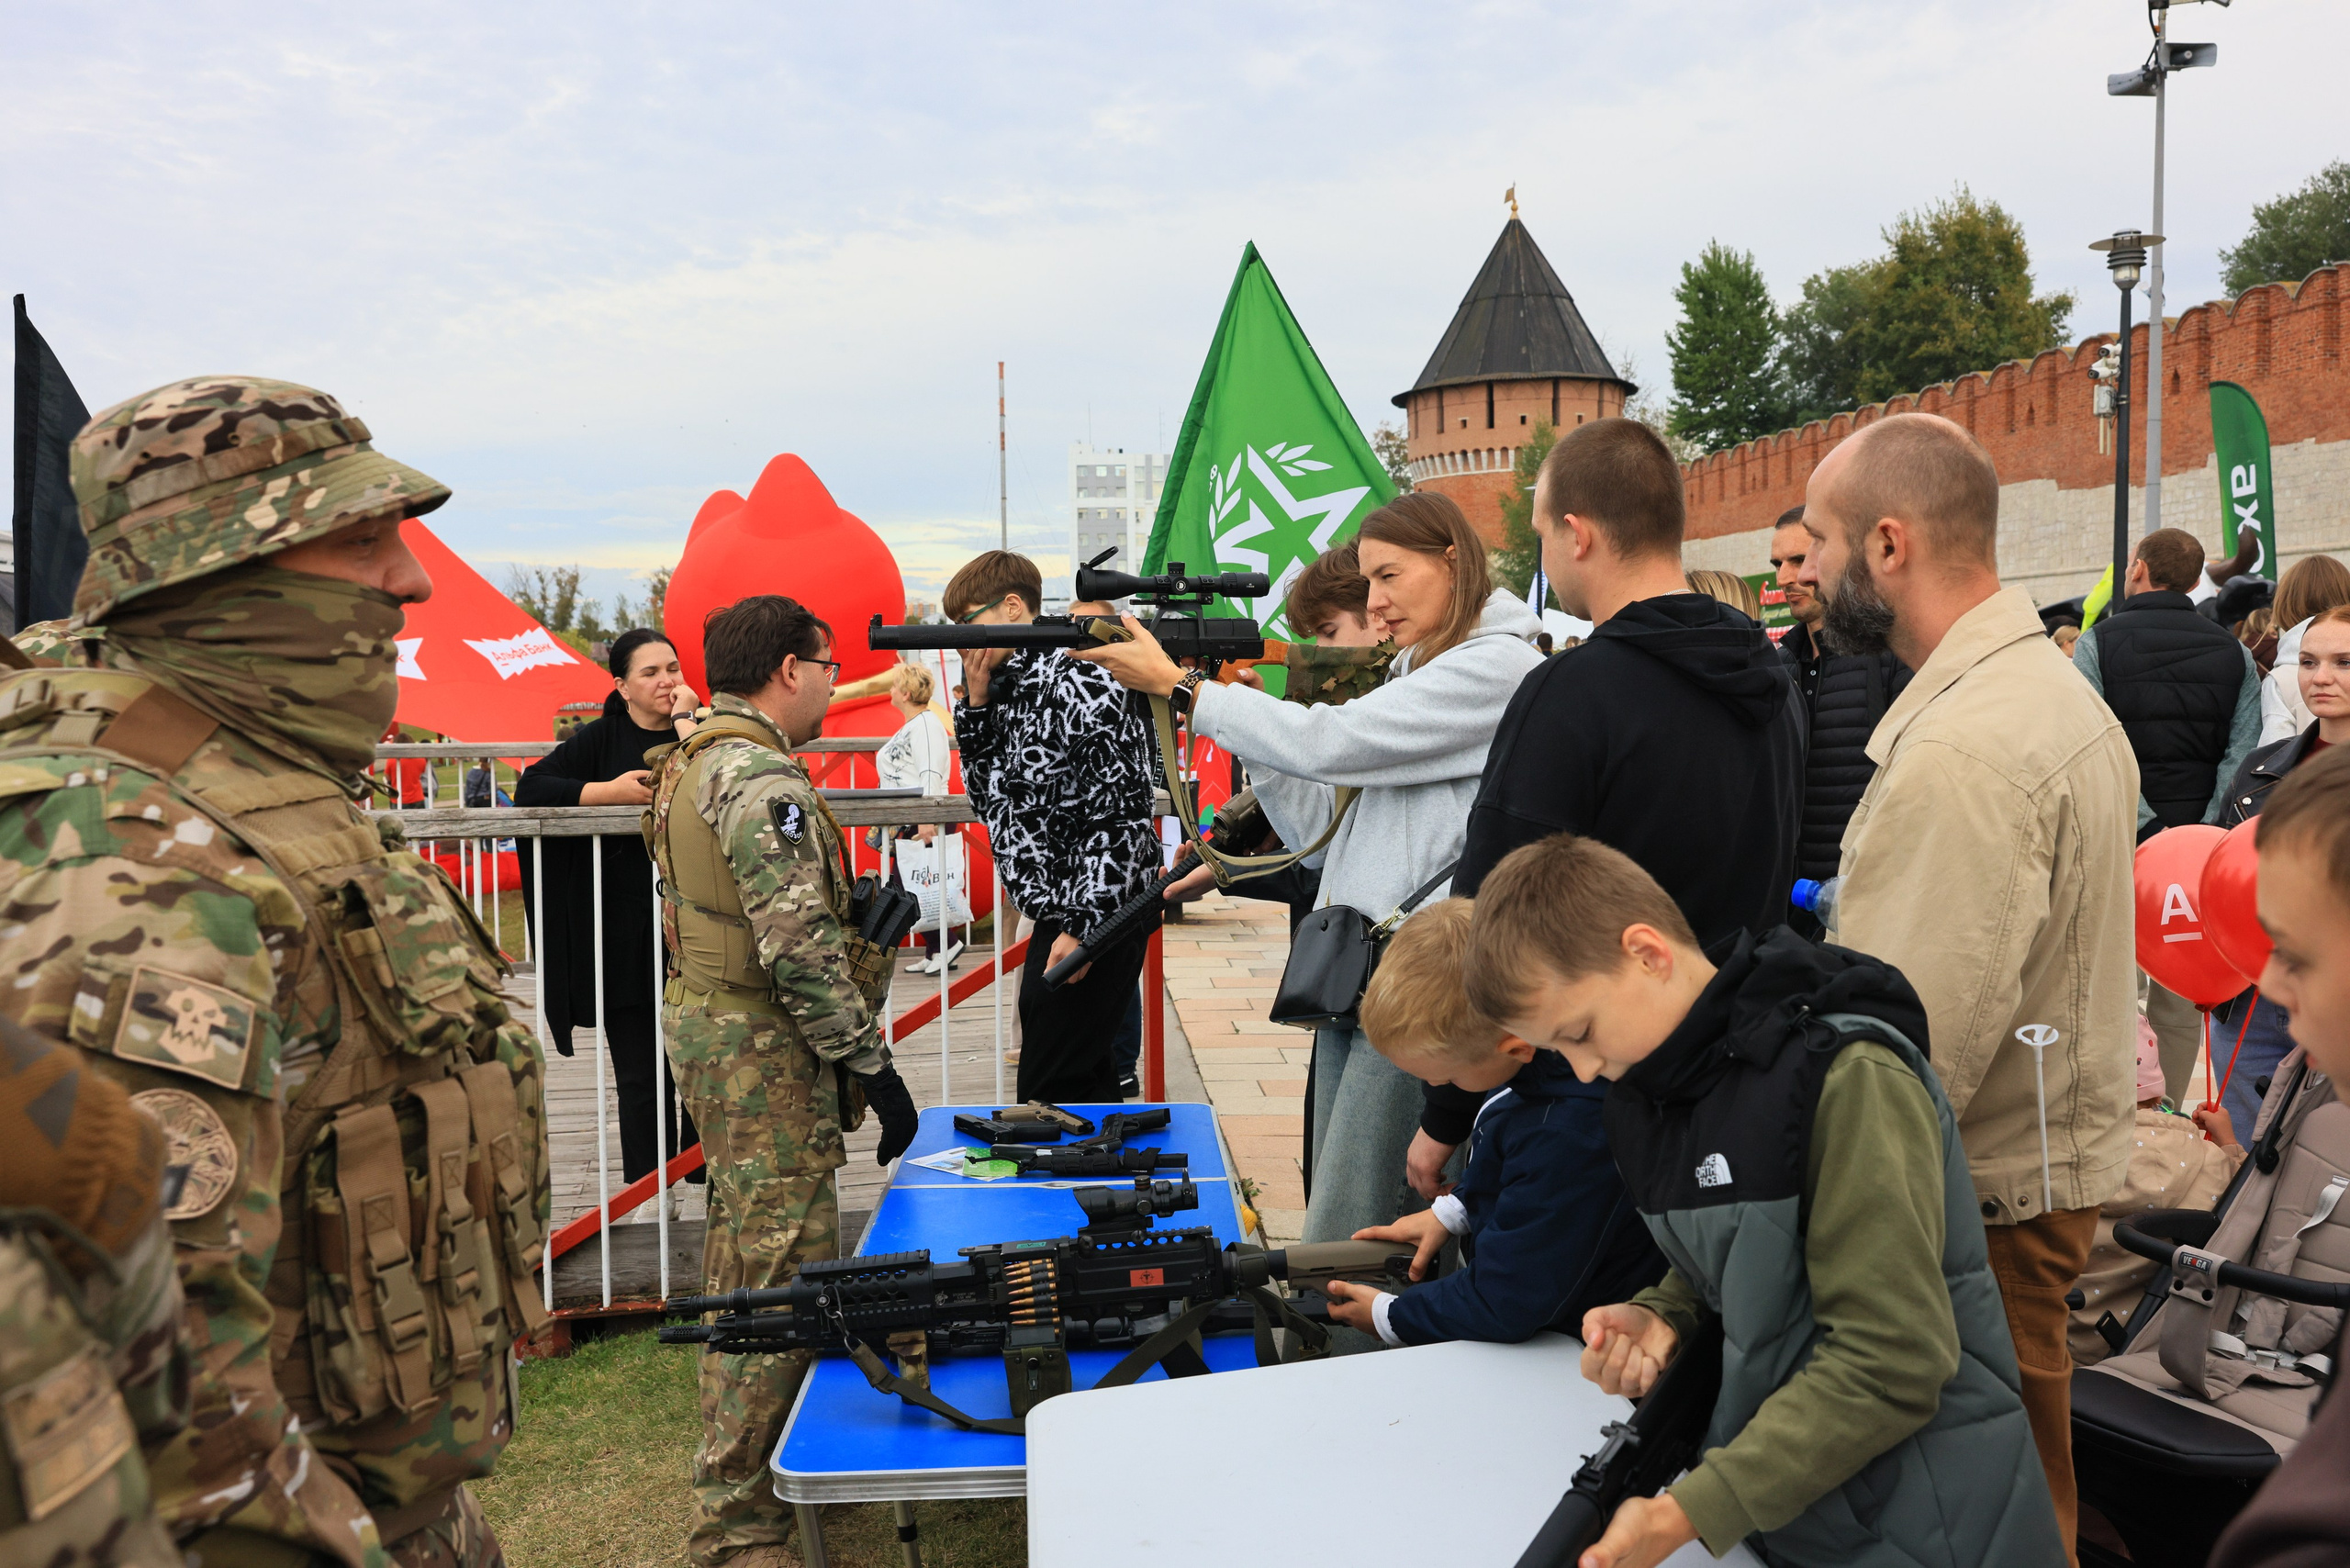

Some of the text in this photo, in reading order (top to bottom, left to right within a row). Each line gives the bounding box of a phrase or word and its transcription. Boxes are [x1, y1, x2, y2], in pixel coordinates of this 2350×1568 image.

[491, 643, 554, 666] Альфа Банк
[2160, 883, 2199, 926] А
[1695, 1165, 1717, 1179] ORTH
[1699, 1174, 1718, 1189] FACE
